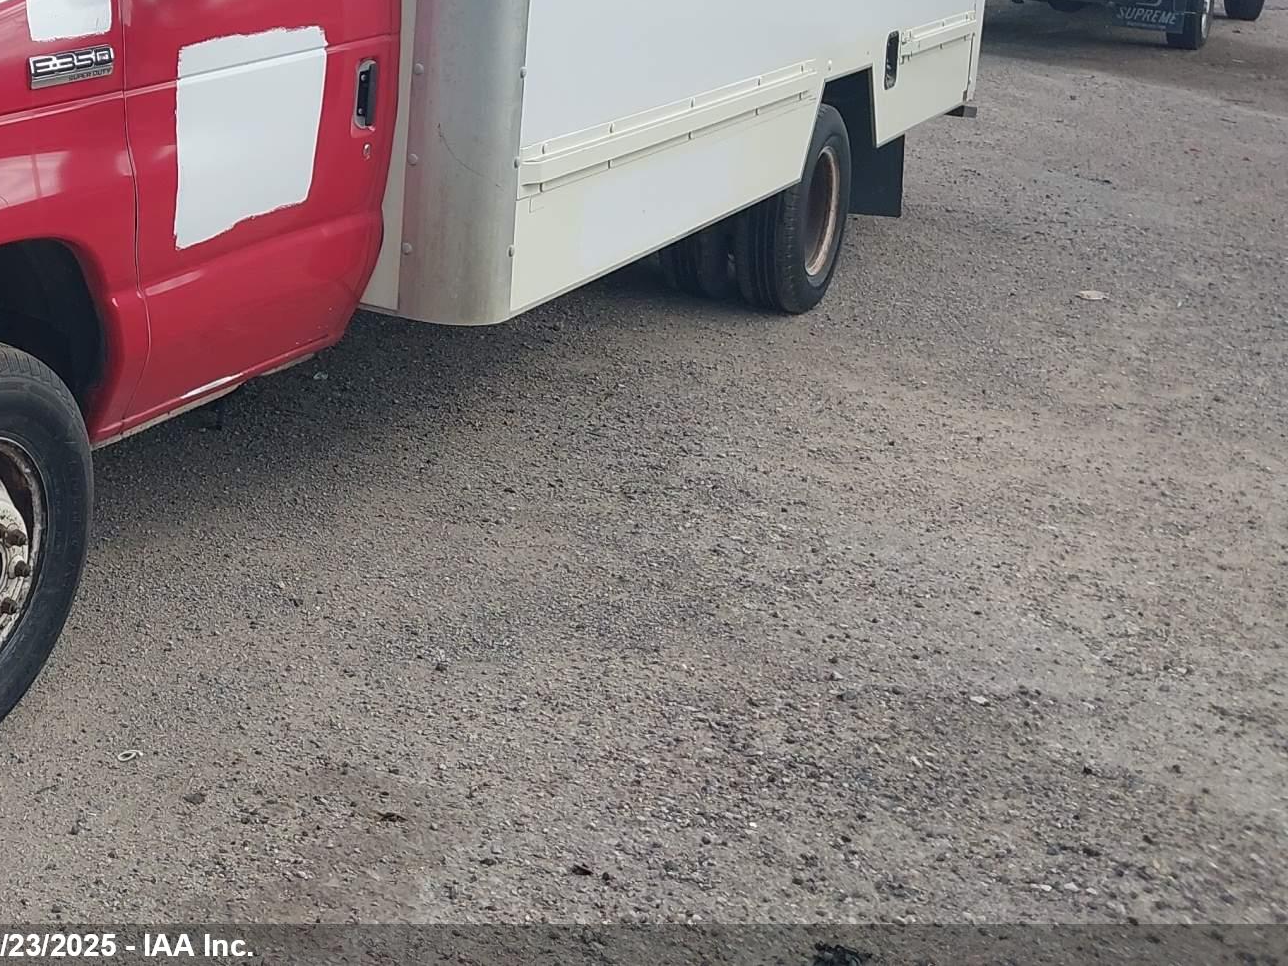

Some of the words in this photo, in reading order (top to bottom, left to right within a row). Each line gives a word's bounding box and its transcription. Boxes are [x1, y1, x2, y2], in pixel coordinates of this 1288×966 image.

[1117, 7, 1177, 25] SUPREME
[68, 72, 92, 81] SUPER
[93, 68, 112, 77] DUTY
